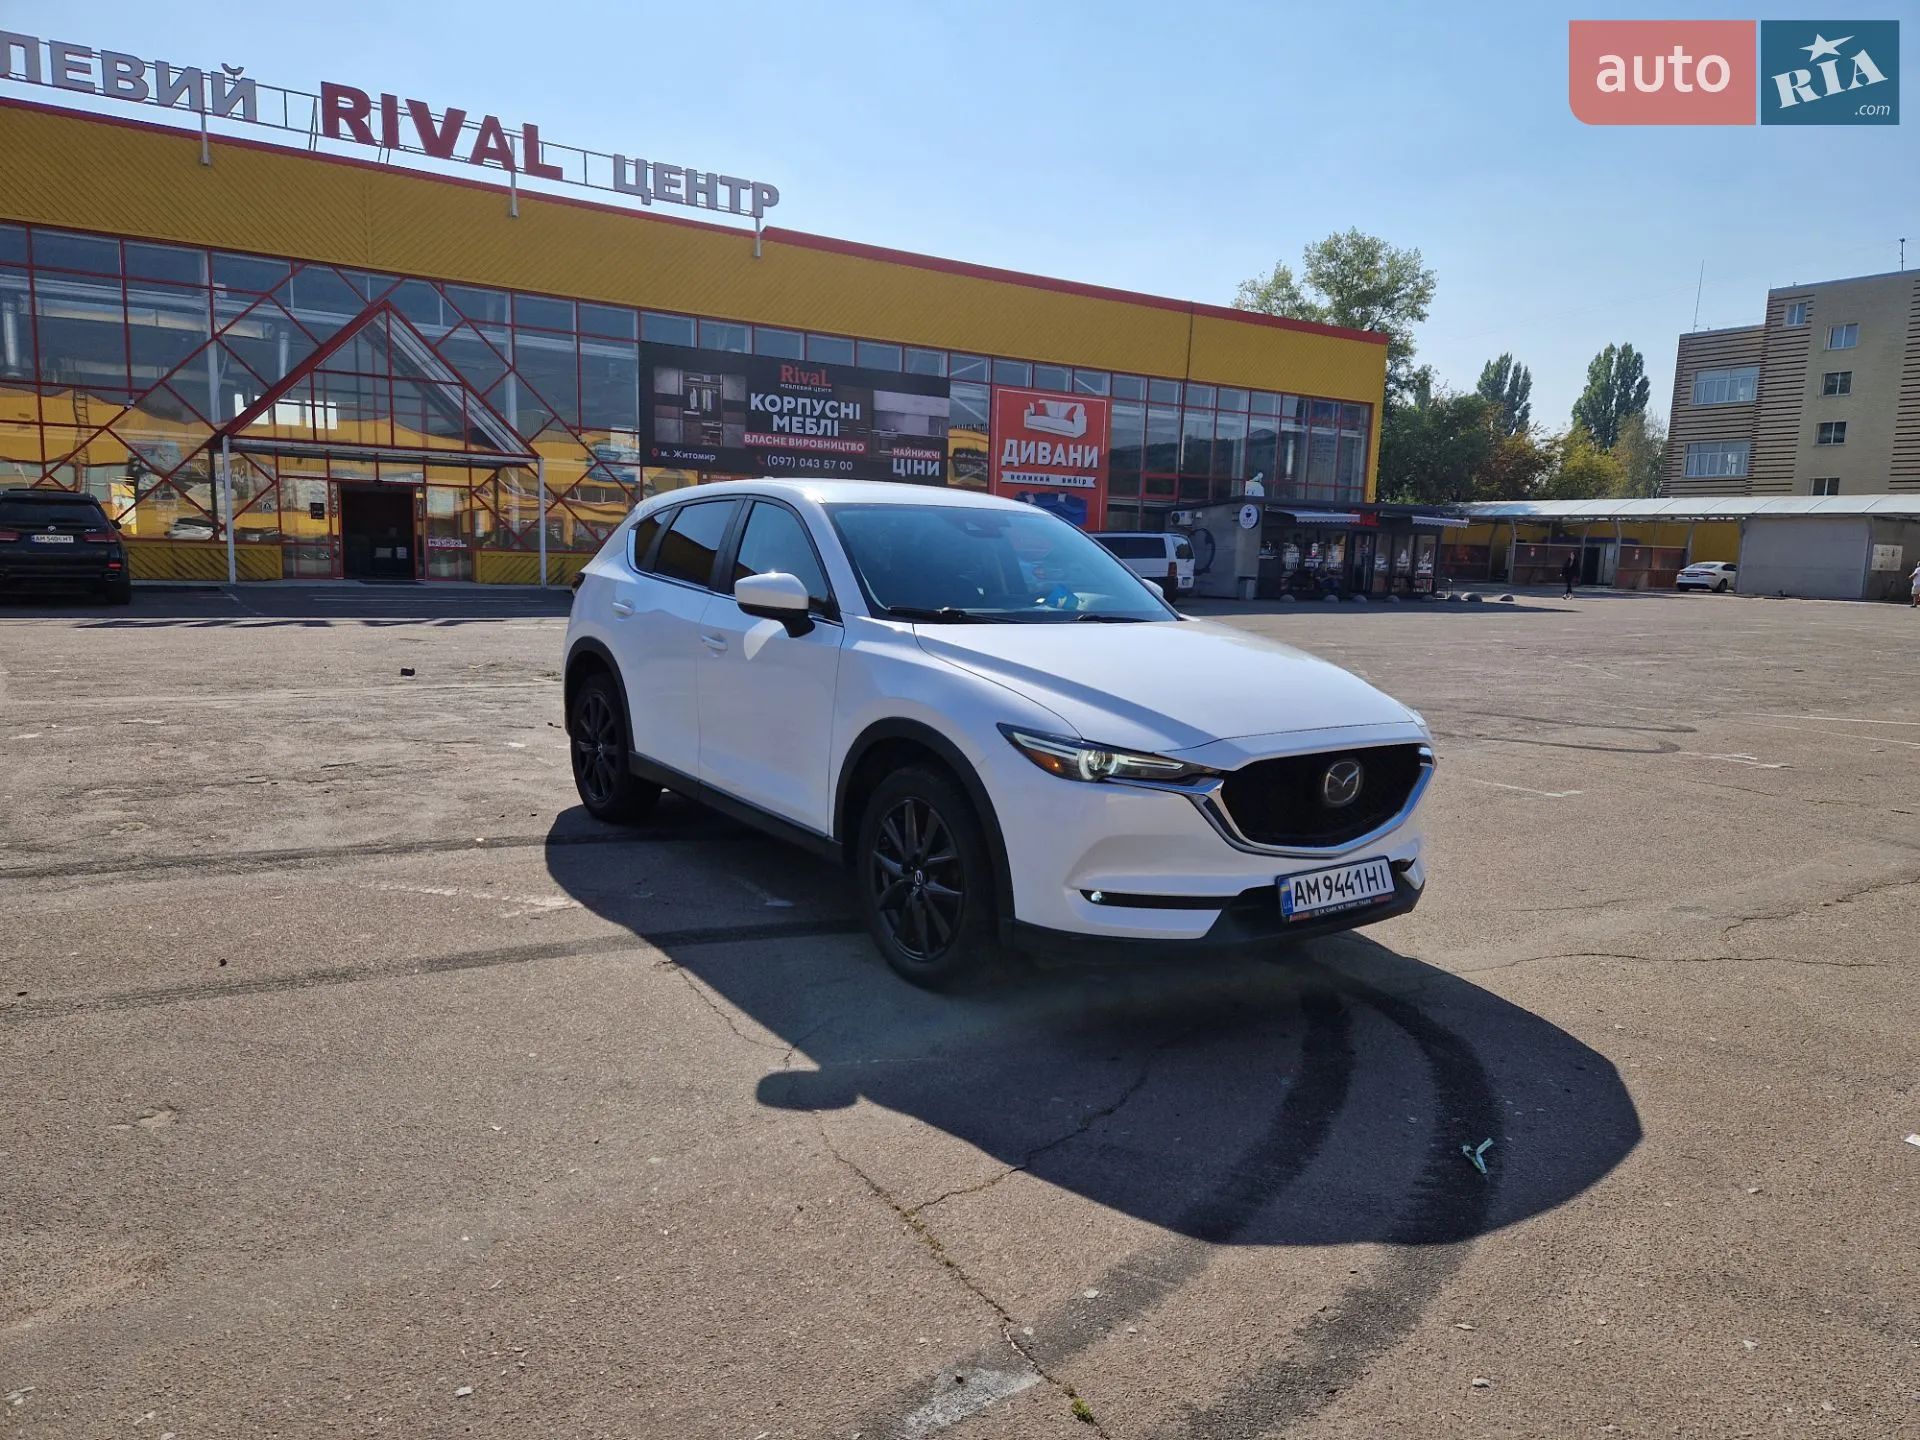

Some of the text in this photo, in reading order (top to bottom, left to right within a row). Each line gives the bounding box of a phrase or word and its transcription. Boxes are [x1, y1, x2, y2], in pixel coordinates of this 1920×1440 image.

[320, 81, 563, 181] RIVAL
[613, 153, 780, 219] ЦЕНТР
[750, 392, 861, 420] КОРПУСНІ
[772, 414, 839, 437] МЕБЛІ
[744, 434, 865, 452] ВЛАСНЕ ВИРОБНИЦТВО
[893, 446, 940, 459] НАЙНИЖЧІ
[673, 449, 716, 462] Житомир
[767, 454, 853, 471] (097) 043 57 00
[1001, 438, 1099, 469] ДИВАНИ
[892, 457, 940, 477] ЦІНИ
[1010, 473, 1087, 485] великий вибір
